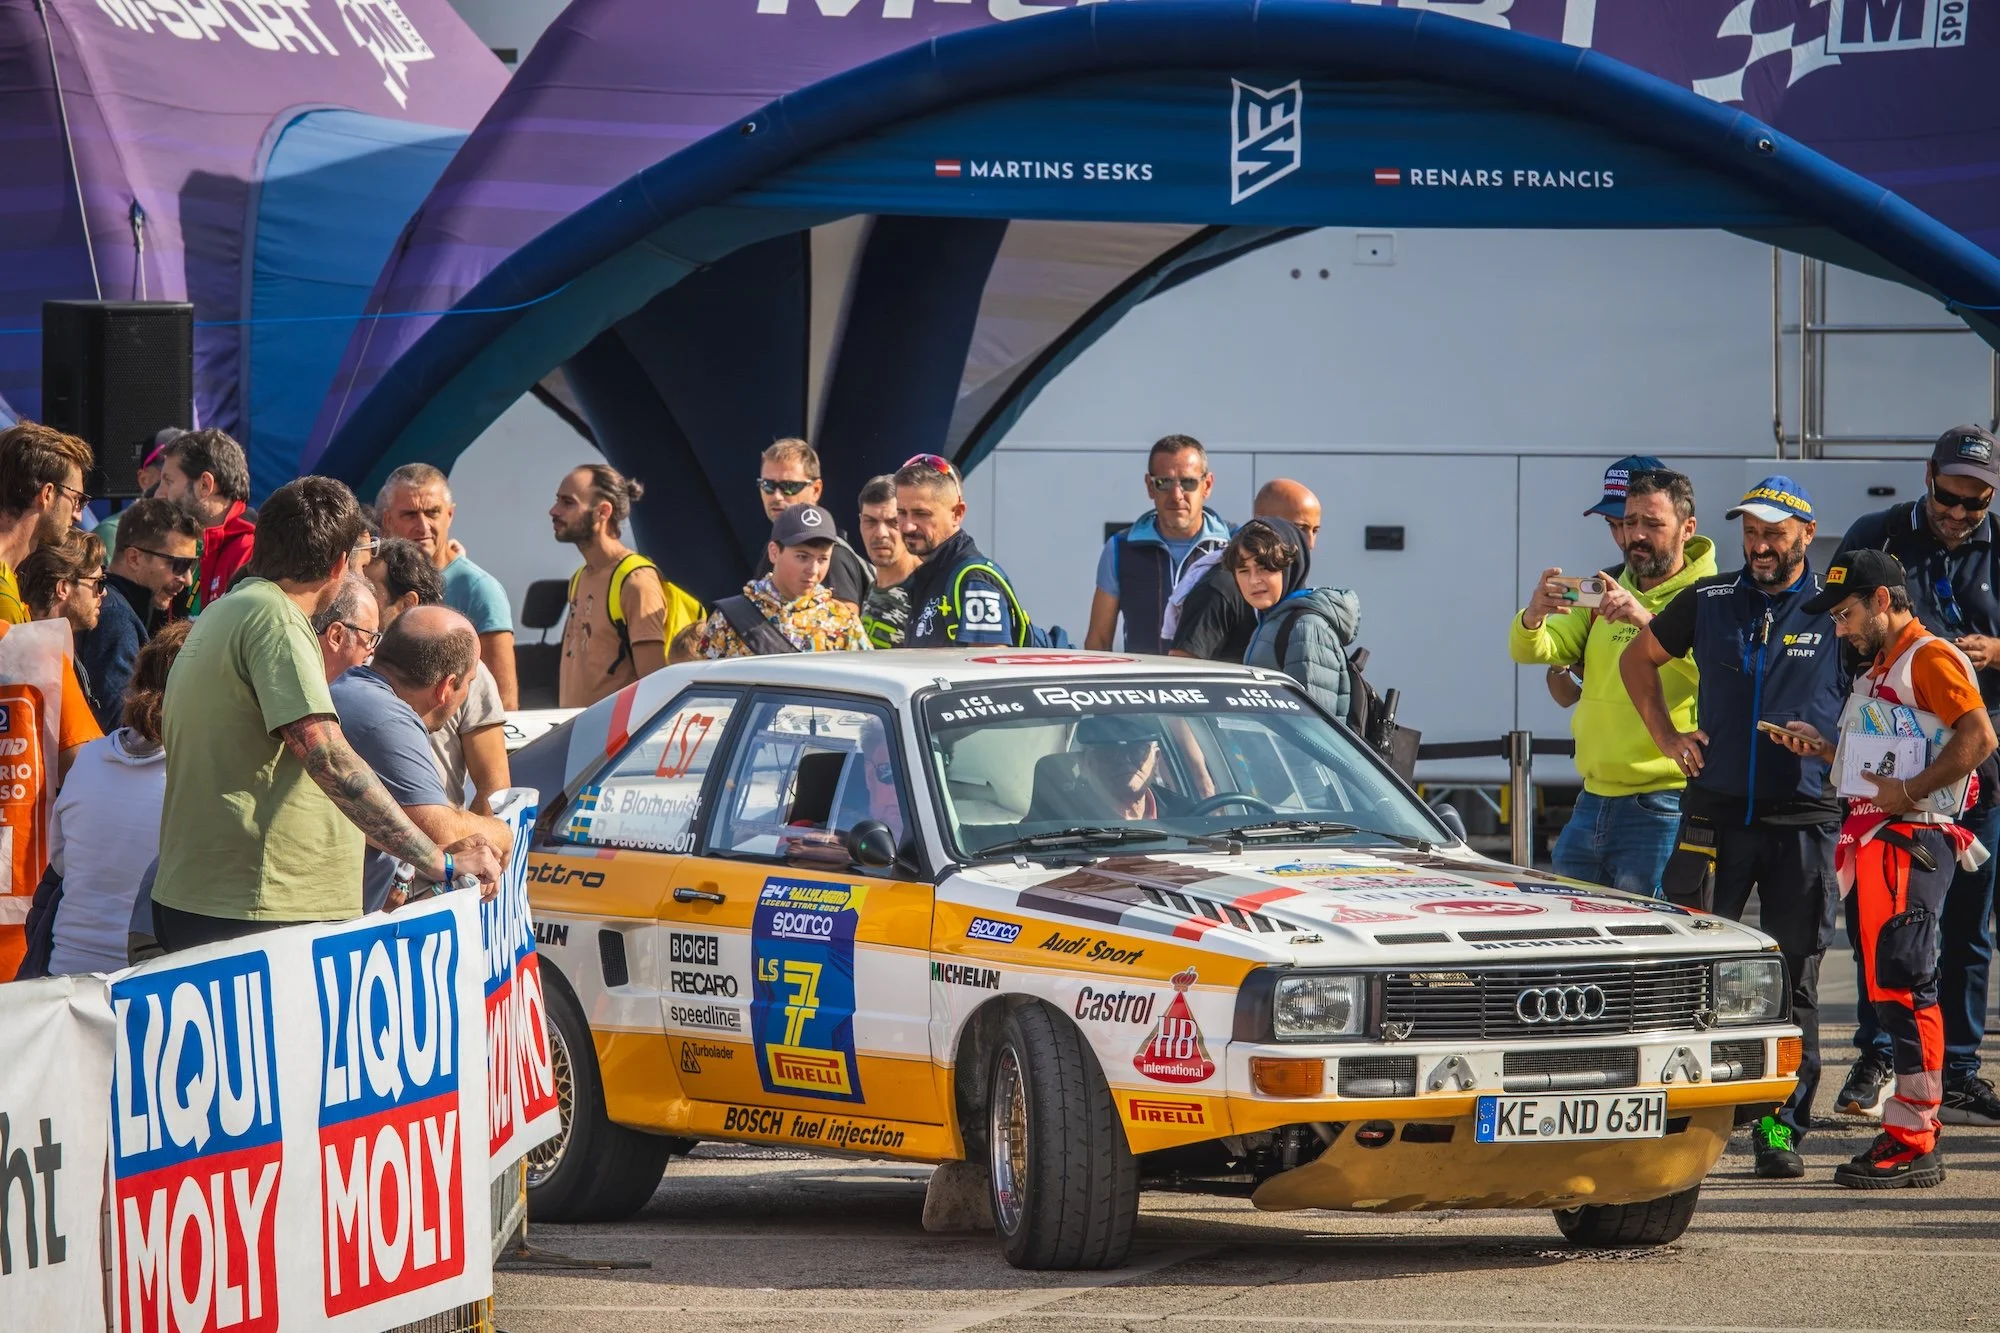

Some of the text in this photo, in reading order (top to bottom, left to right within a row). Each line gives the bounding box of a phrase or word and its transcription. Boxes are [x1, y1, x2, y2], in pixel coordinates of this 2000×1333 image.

[970, 160, 1153, 181] MARTINS SESKS
[1410, 168, 1614, 189] RENARS FRANCIS
[1706, 586, 1735, 598] sparco
[965, 598, 1002, 623] 03
[1786, 648, 1817, 658] STAFF
[960, 695, 994, 708] ICE
[1032, 686, 1210, 712] ROUTEVARE
[1225, 697, 1300, 711] DRIVING
[1240, 688, 1272, 699] ICE
[941, 702, 1025, 722] DRIVING
[600, 787, 702, 822] S. Blomqvist
[761, 899, 841, 912] LEGEND STARS 2026
[1432, 902, 1540, 914] AUDI
[772, 911, 833, 938] sparco
[970, 918, 1020, 939] sparco
[671, 936, 717, 962] BOGE
[1038, 932, 1145, 965] Audi Sport
[1471, 939, 1624, 950] MICHELIN
[671, 970, 738, 998] RECARO
[931, 961, 1000, 990] MICHELIN
[758, 958, 823, 1047] LS 7
[1075, 986, 1156, 1025] Castrol
[320, 930, 453, 1106] LIQUI
[671, 1005, 737, 1027] speedline
[1154, 1015, 1198, 1060] HB
[691, 1043, 734, 1060] Turbolader
[114, 971, 274, 1159] LIQUI
[774, 1052, 842, 1086] PIRELLI
[1143, 1060, 1204, 1078] international
[1129, 1098, 1205, 1125] PIRELLI
[1496, 1096, 1663, 1137] KE ND 63H
[724, 1107, 905, 1148] BOSCH fuel injection
[1482, 1123, 1490, 1134] D
[324, 1109, 458, 1298] MOLY
[124, 1160, 281, 1333] MOLY
